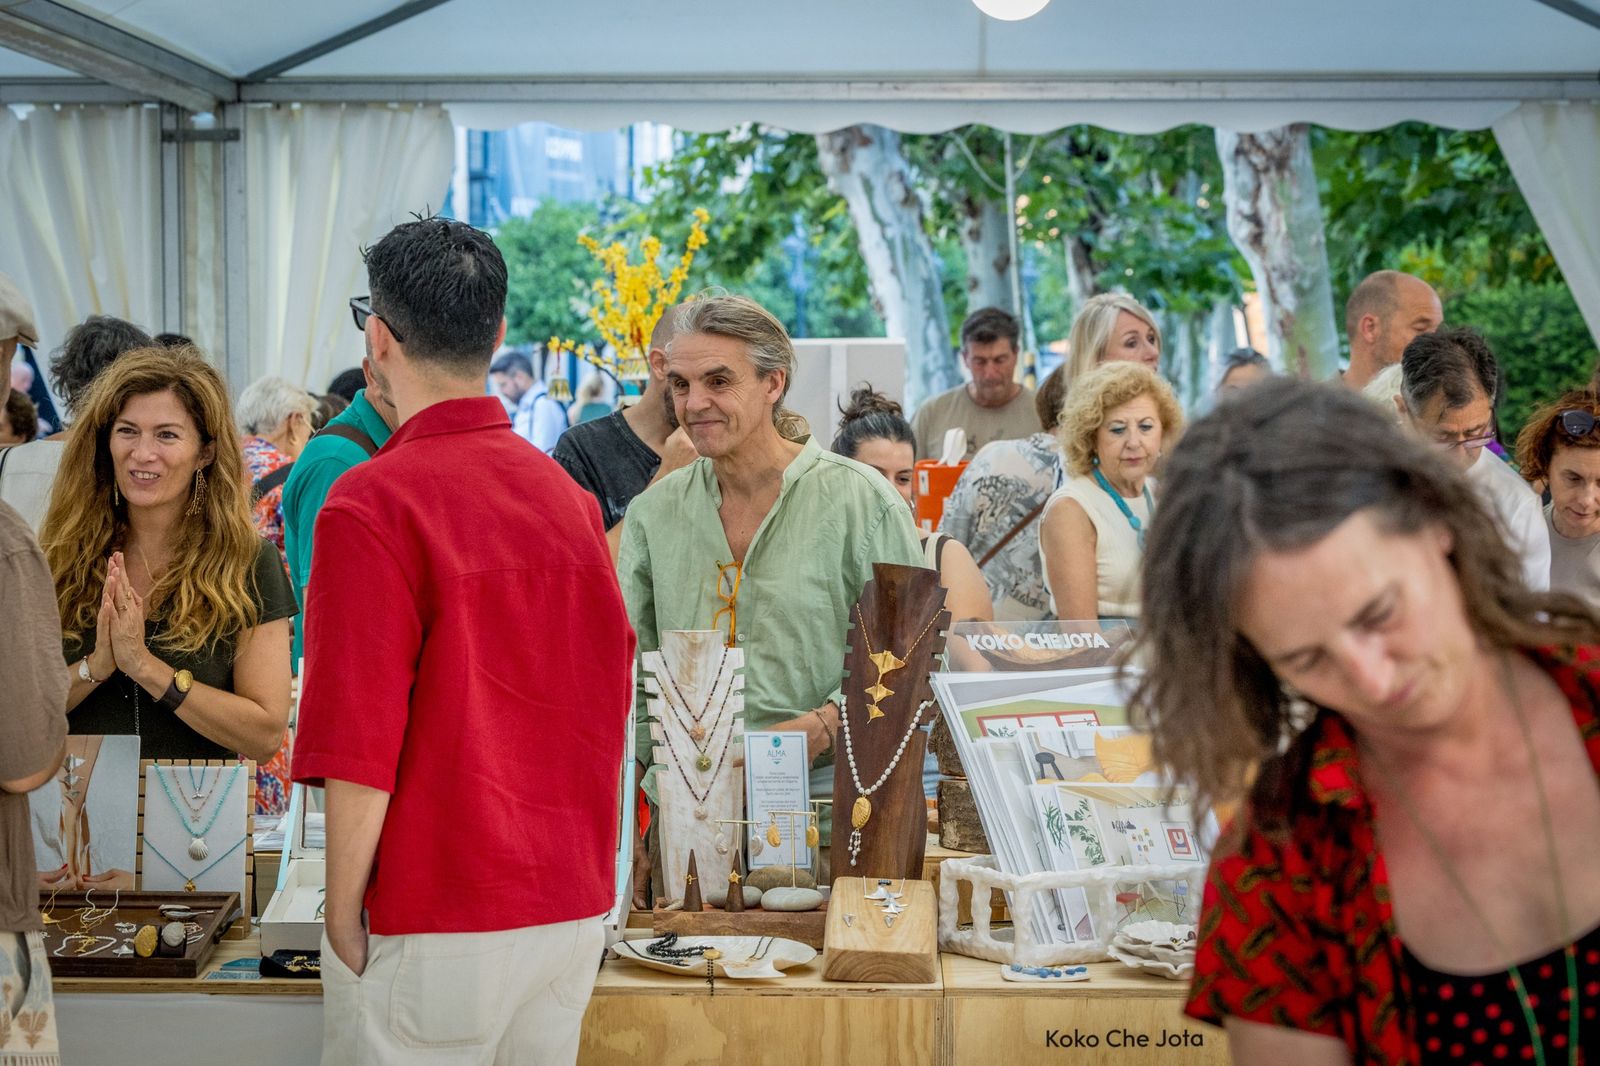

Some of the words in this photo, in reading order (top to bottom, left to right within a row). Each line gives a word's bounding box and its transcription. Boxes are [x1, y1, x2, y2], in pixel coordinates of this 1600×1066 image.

[966, 633, 1025, 651] KOKO
[767, 750, 787, 758] ALMA
[1045, 1029, 1100, 1048] Koko
[1106, 1028, 1150, 1048] Che
[1155, 1029, 1205, 1048] Jota
